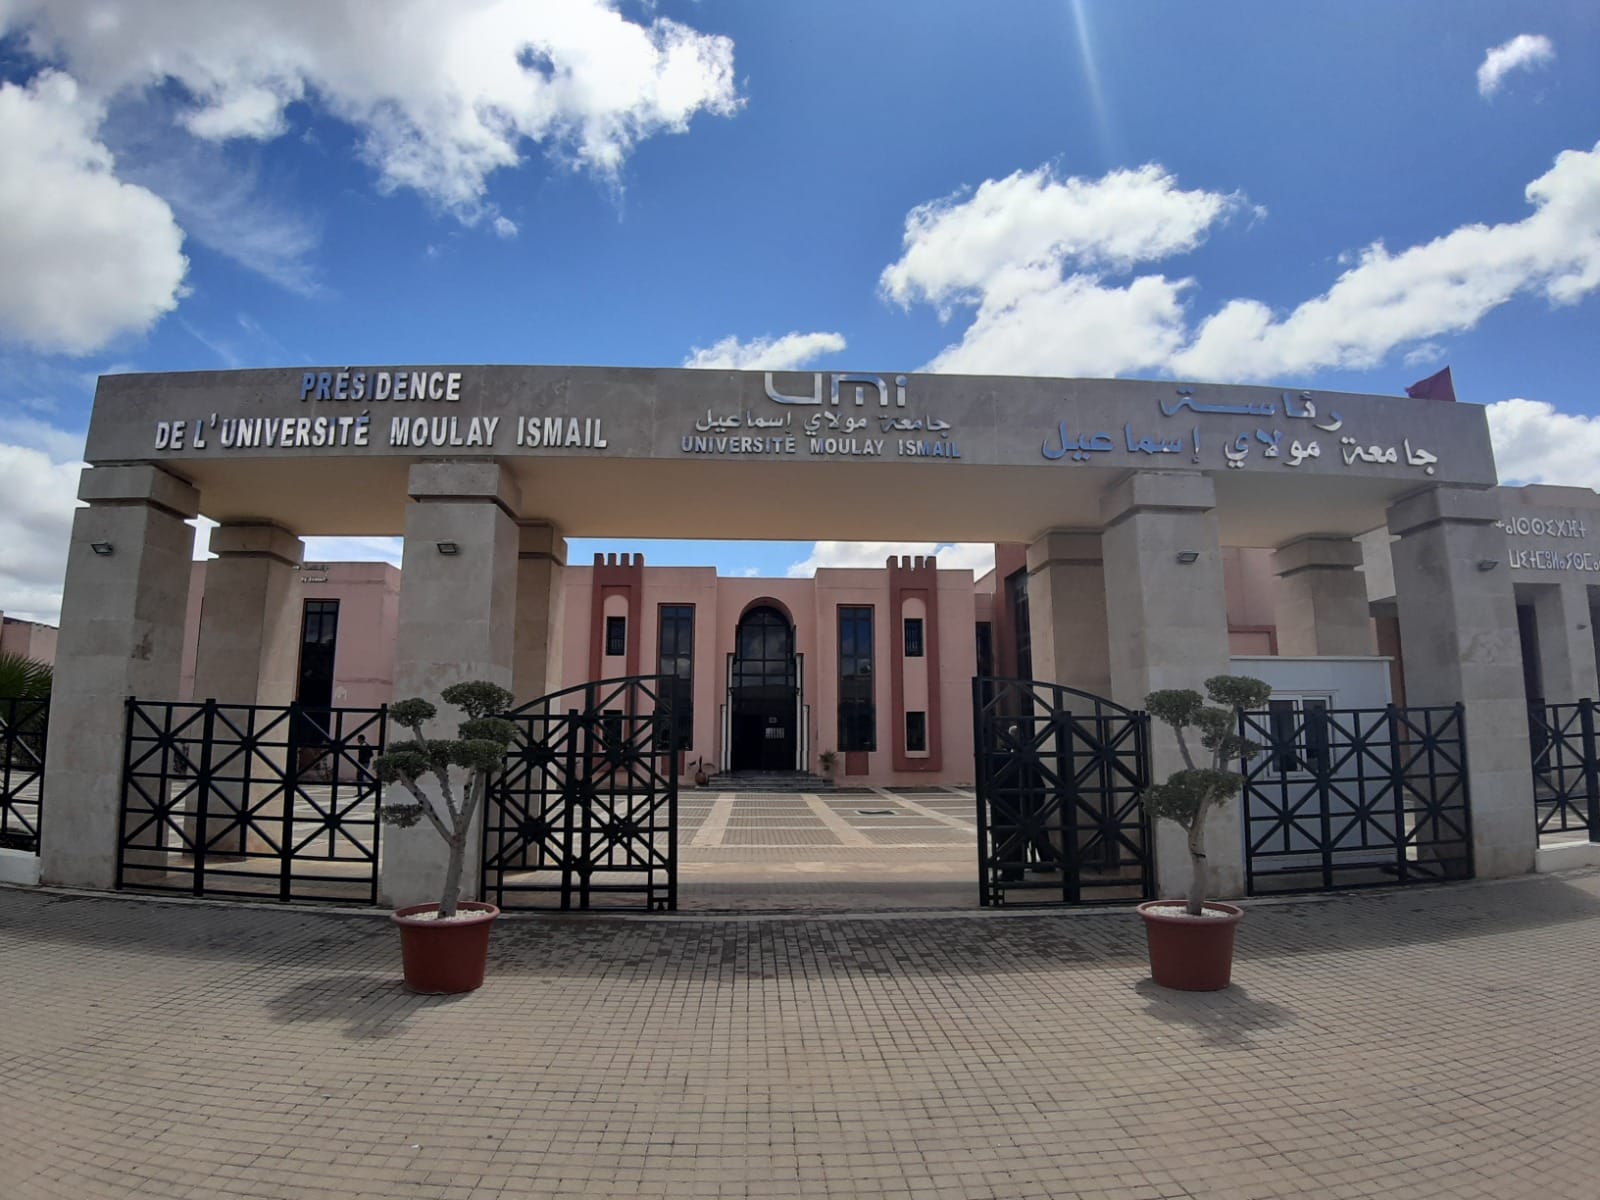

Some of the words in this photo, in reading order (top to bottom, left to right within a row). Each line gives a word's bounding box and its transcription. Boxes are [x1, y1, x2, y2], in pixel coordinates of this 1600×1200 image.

[300, 366, 462, 401] PRÉSIDENCE
[155, 420, 186, 449] DE
[193, 411, 369, 448] L'UNIVERSITÉ
[389, 416, 499, 447] MOULAY
[517, 416, 608, 448] ISMAIL
[696, 409, 792, 435] إسماعيل
[804, 410, 868, 435] مولاي
[878, 413, 952, 439] جامعة
[681, 432, 796, 454] UNIVERSITÉ
[810, 438, 884, 456] MOULAY
[899, 438, 961, 458] ISMAIL
[1042, 421, 1200, 464] إسماعيل
[1224, 428, 1321, 468] مولاي
[1340, 437, 1439, 475] جامعة
